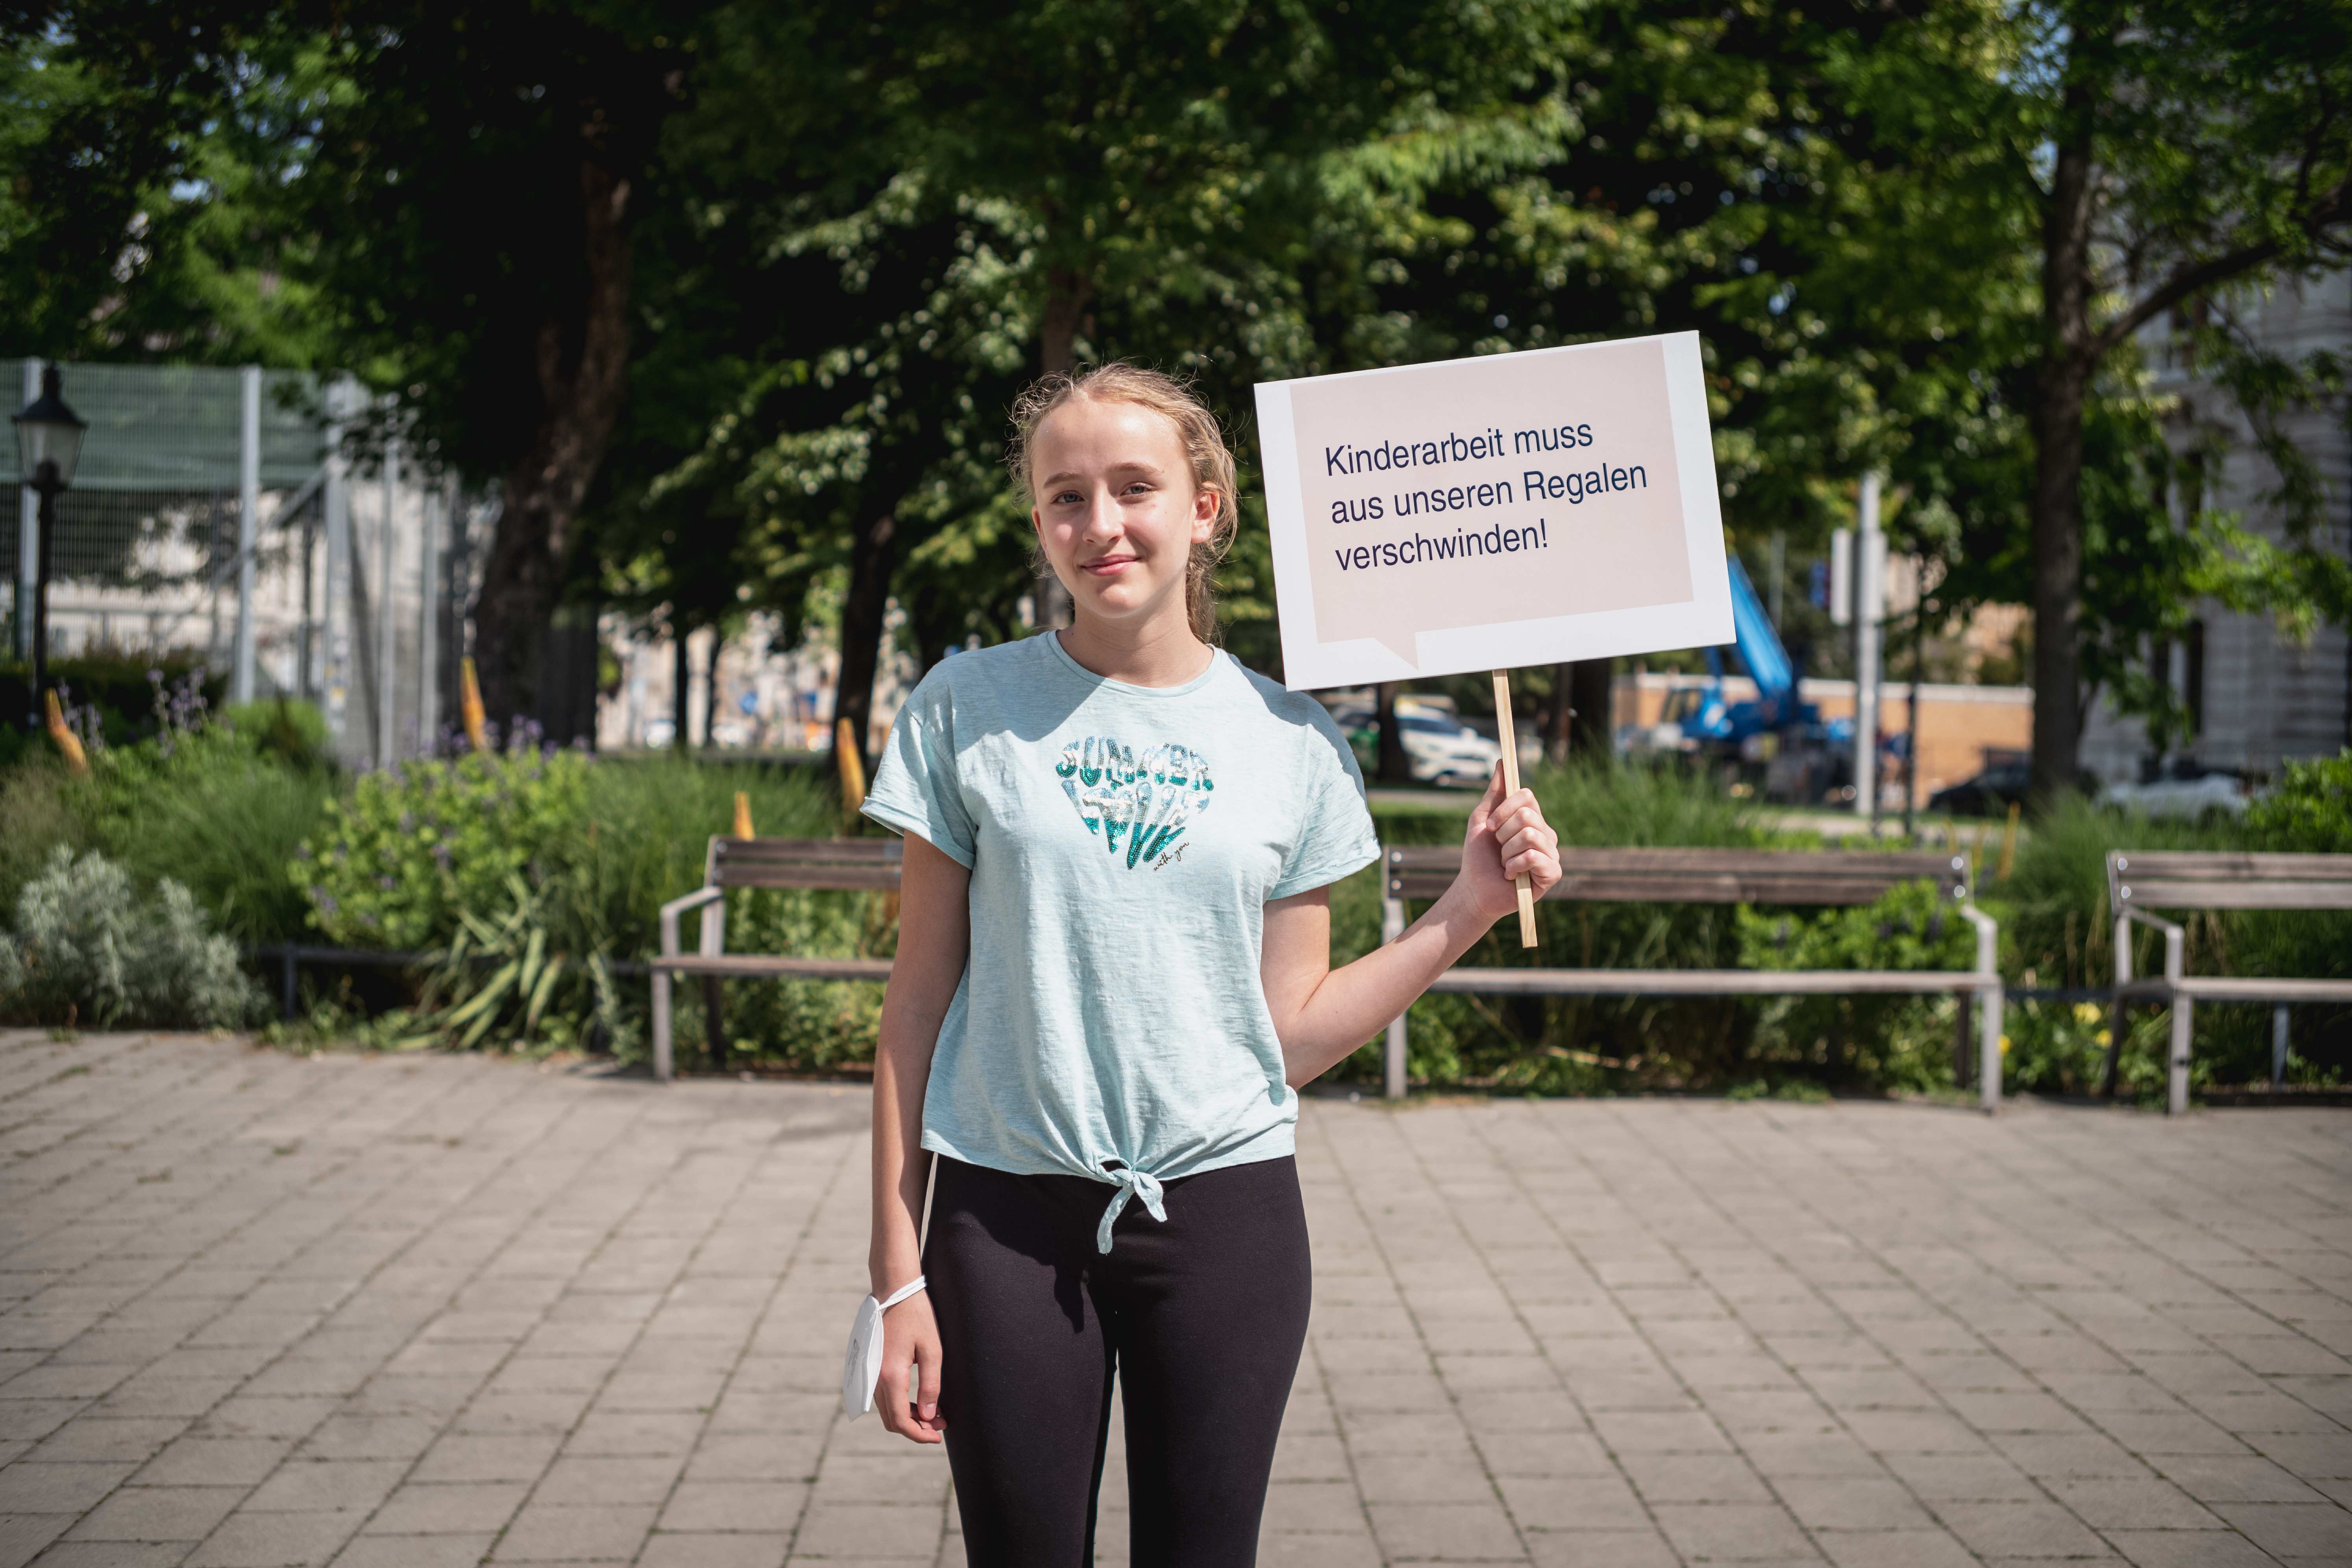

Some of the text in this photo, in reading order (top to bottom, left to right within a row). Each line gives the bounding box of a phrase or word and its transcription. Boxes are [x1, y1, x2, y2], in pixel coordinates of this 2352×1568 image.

[1326, 424, 1593, 476] Kinderarbeit muss
[1332, 462, 1647, 524] aus unseren Regalen
[1335, 518, 1548, 571] verschwinden!
[1056, 735, 1214, 792] SUMMER
[1154, 842, 1189, 871] with you
